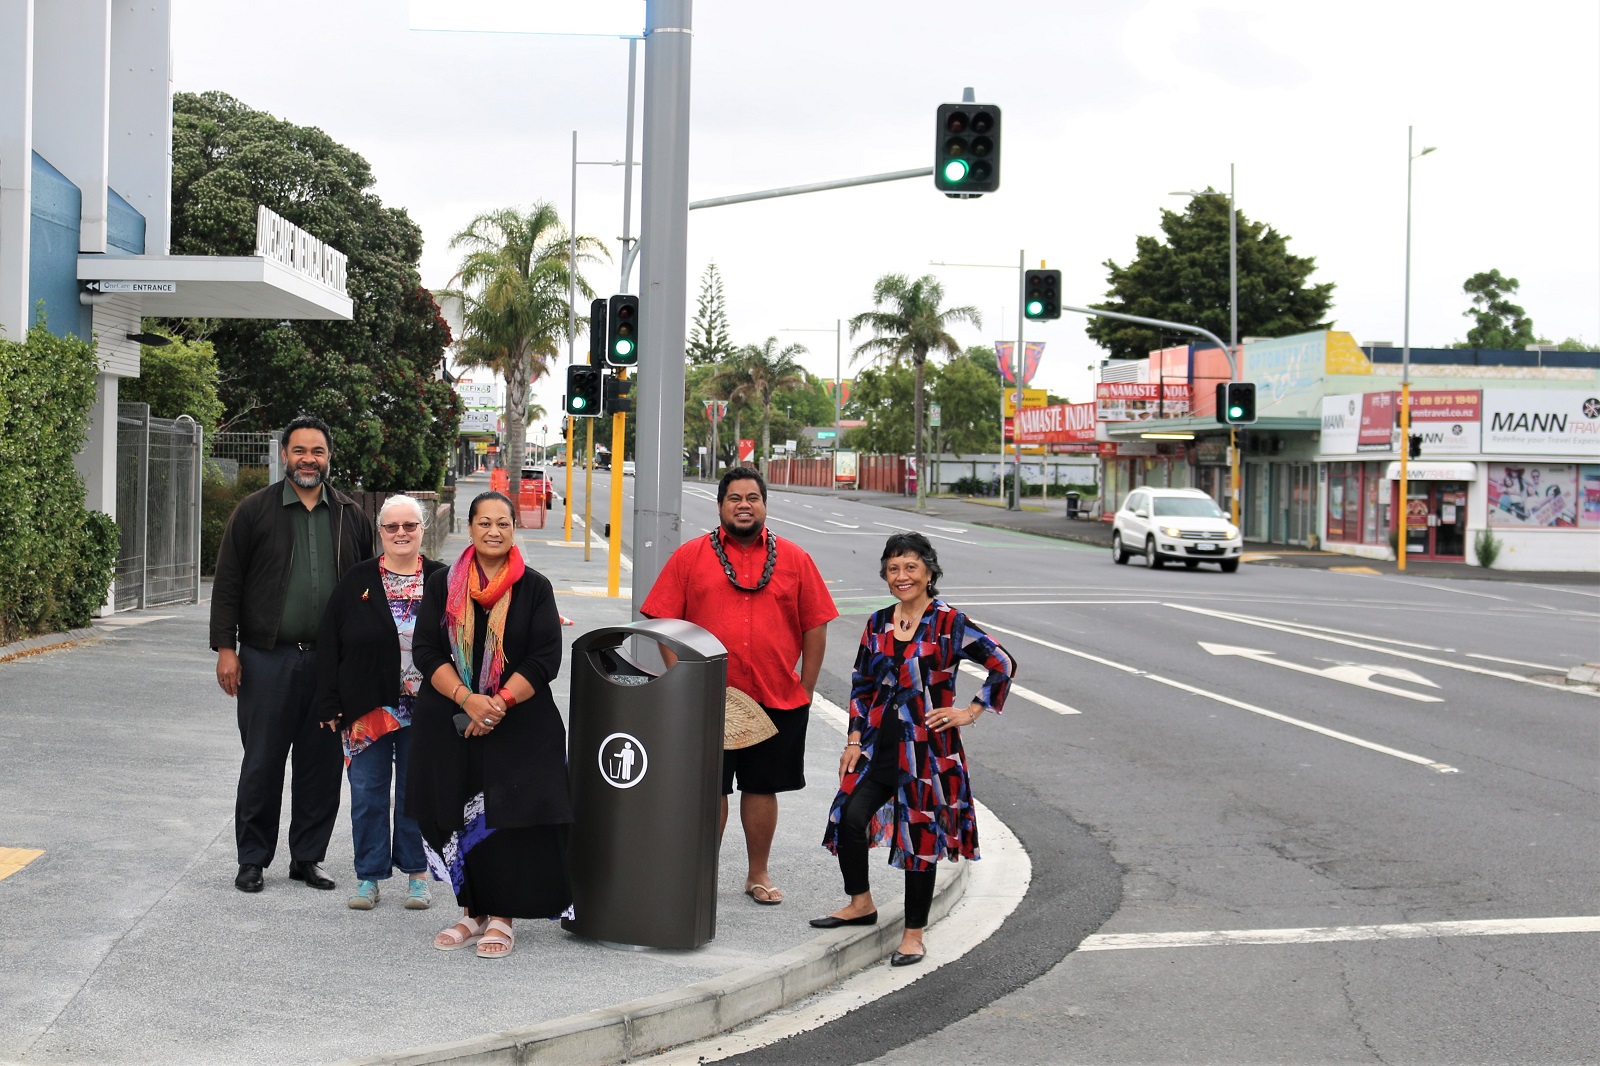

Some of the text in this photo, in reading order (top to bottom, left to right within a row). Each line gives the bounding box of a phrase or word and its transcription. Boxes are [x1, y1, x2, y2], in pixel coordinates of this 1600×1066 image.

[257, 205, 296, 268] ONECARE
[295, 225, 324, 284] MEDICAL
[1109, 384, 1189, 397] NAMASTE NDIA
[1396, 396, 1414, 406] Cll
[1021, 404, 1096, 433] NAMASTE INDIA
[1323, 413, 1346, 430] MANN
[1491, 412, 1568, 433] MANN
